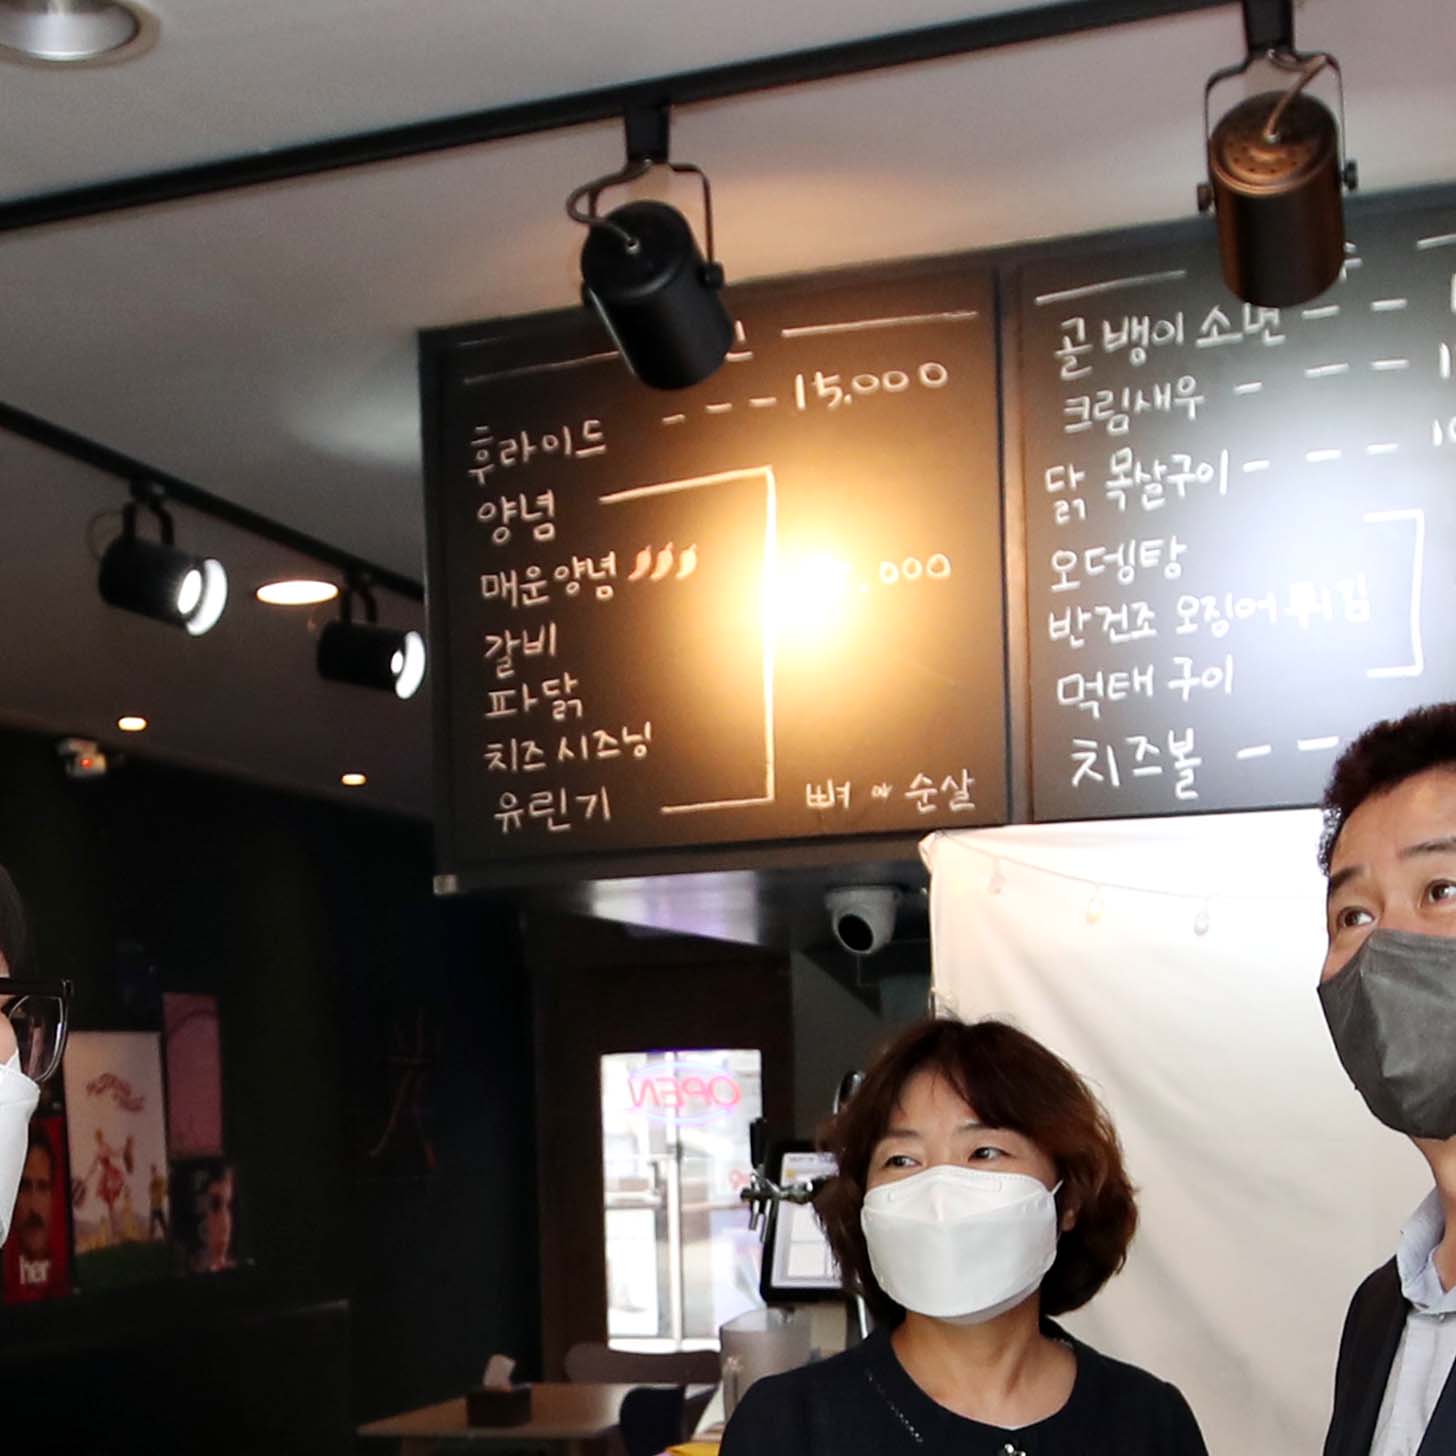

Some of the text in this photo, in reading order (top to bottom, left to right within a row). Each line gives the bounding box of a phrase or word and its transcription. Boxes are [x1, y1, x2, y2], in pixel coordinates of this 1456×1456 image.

[1064, 375, 1205, 437] 크림새우
[469, 419, 607, 486] 후라이드
[477, 491, 555, 544] 양념
[1050, 535, 1188, 593] 오뎅탕
[1048, 601, 1158, 649] 반건조
[1175, 593, 1278, 638] 오징어
[484, 622, 557, 679] 갈비
[485, 672, 583, 723] 파닭
[805, 778, 850, 810] 뼈
[904, 768, 976, 813] 순살
[1071, 726, 1203, 800] 치즈볼
[494, 786, 612, 834] 유린기
